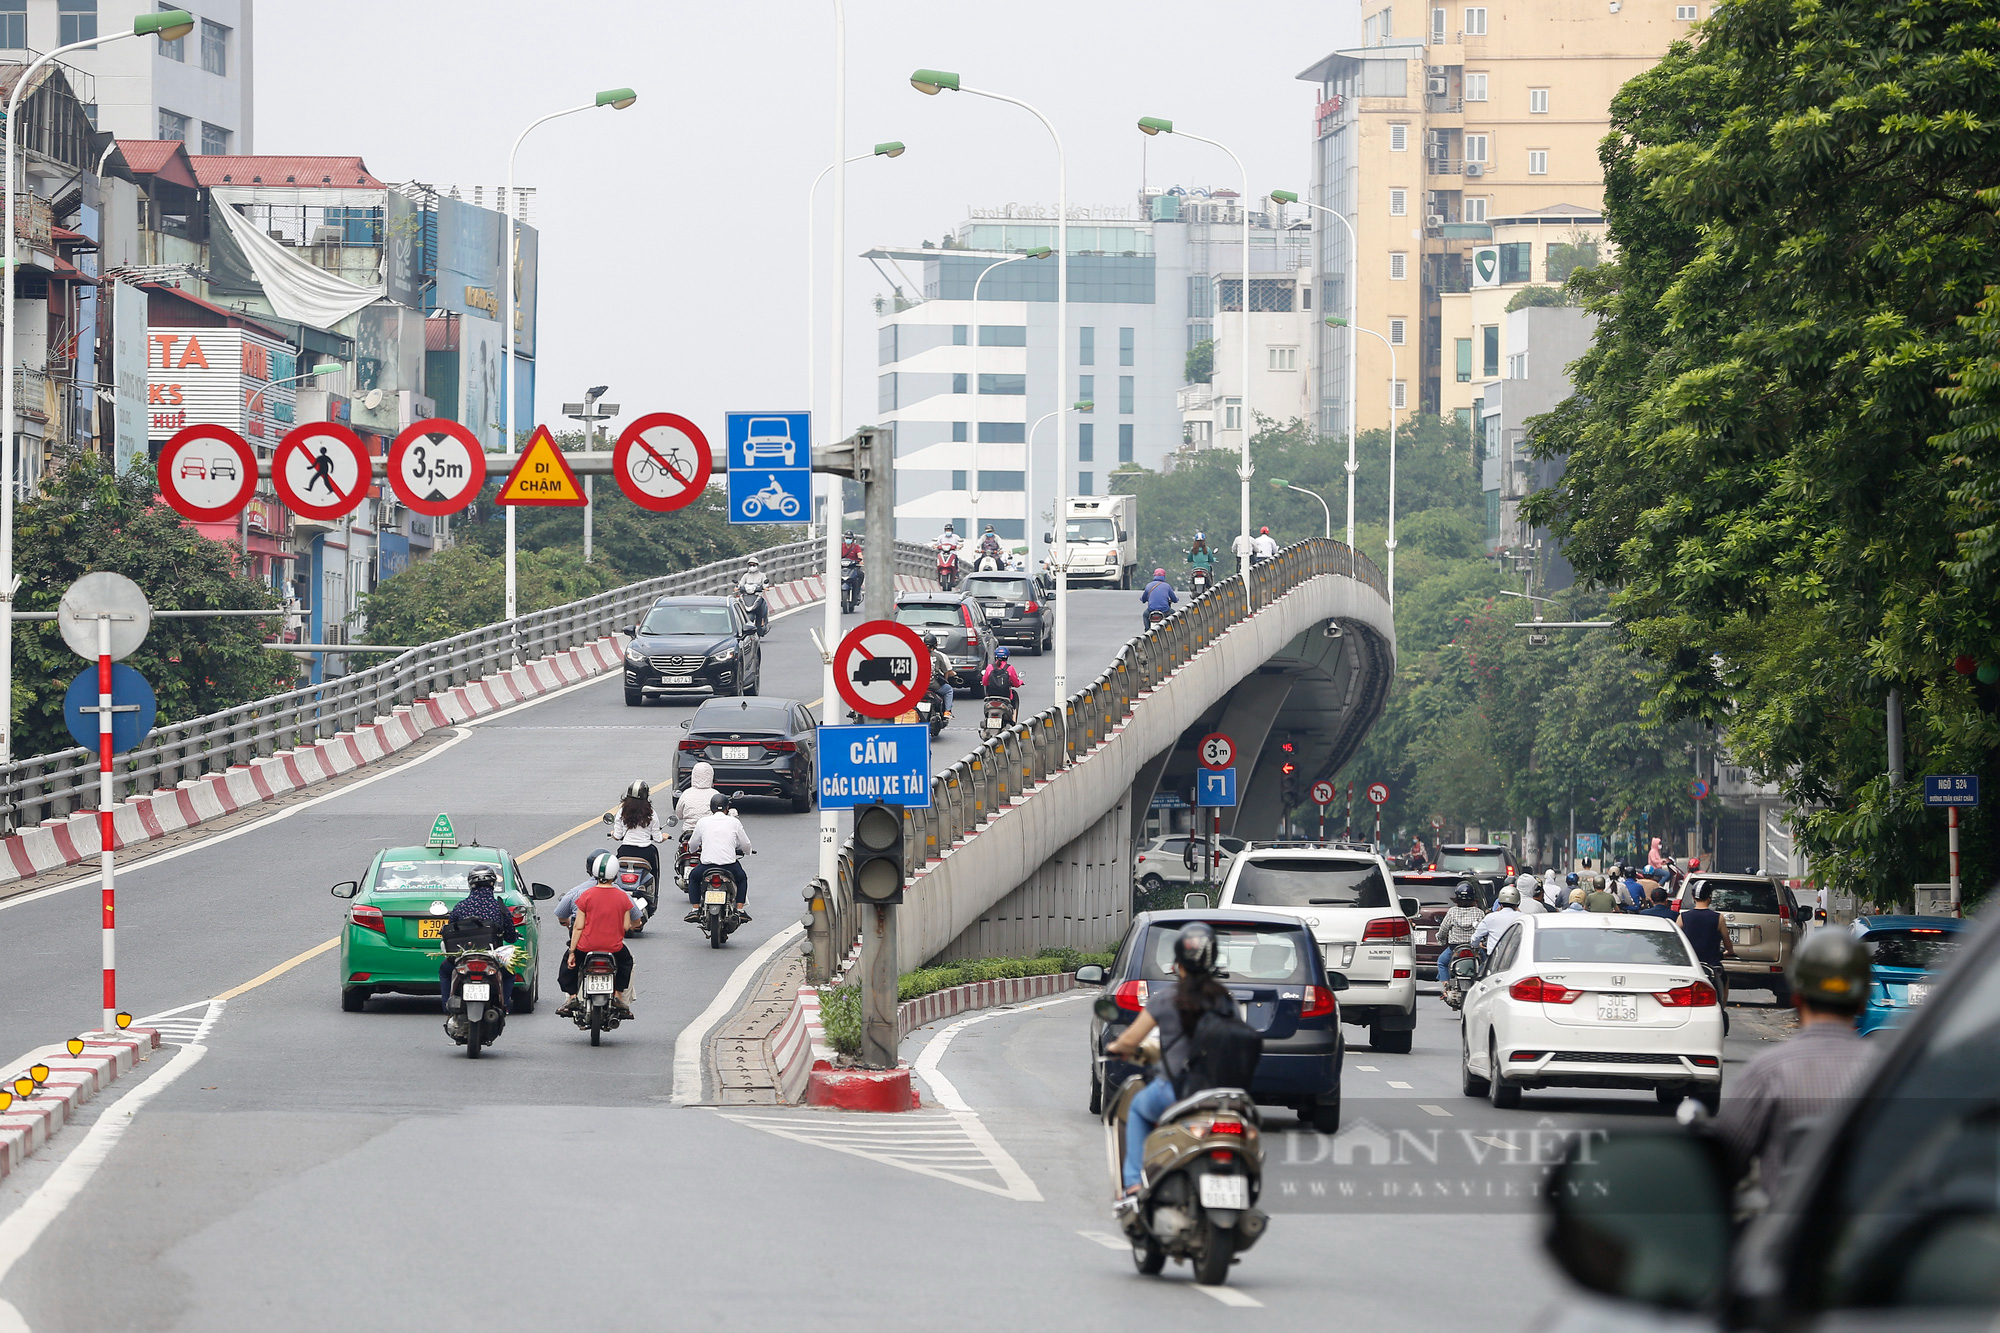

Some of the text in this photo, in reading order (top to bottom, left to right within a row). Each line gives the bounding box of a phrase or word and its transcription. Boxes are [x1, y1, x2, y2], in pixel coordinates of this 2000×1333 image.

[1090, 202, 1132, 218] Hotel
[412, 446, 463, 486] 3,5m
[535, 462, 550, 474] ĐI
[519, 477, 562, 495] CHẬM
[889, 658, 911, 677] 1,25t
[849, 734, 898, 765] CẤM
[1282, 743, 1293, 752] 45
[822, 768, 924, 799] CÁC LOẠI XE TẢI
[1955, 779, 1968, 790] 524
[1606, 994, 1628, 1007] 30E
